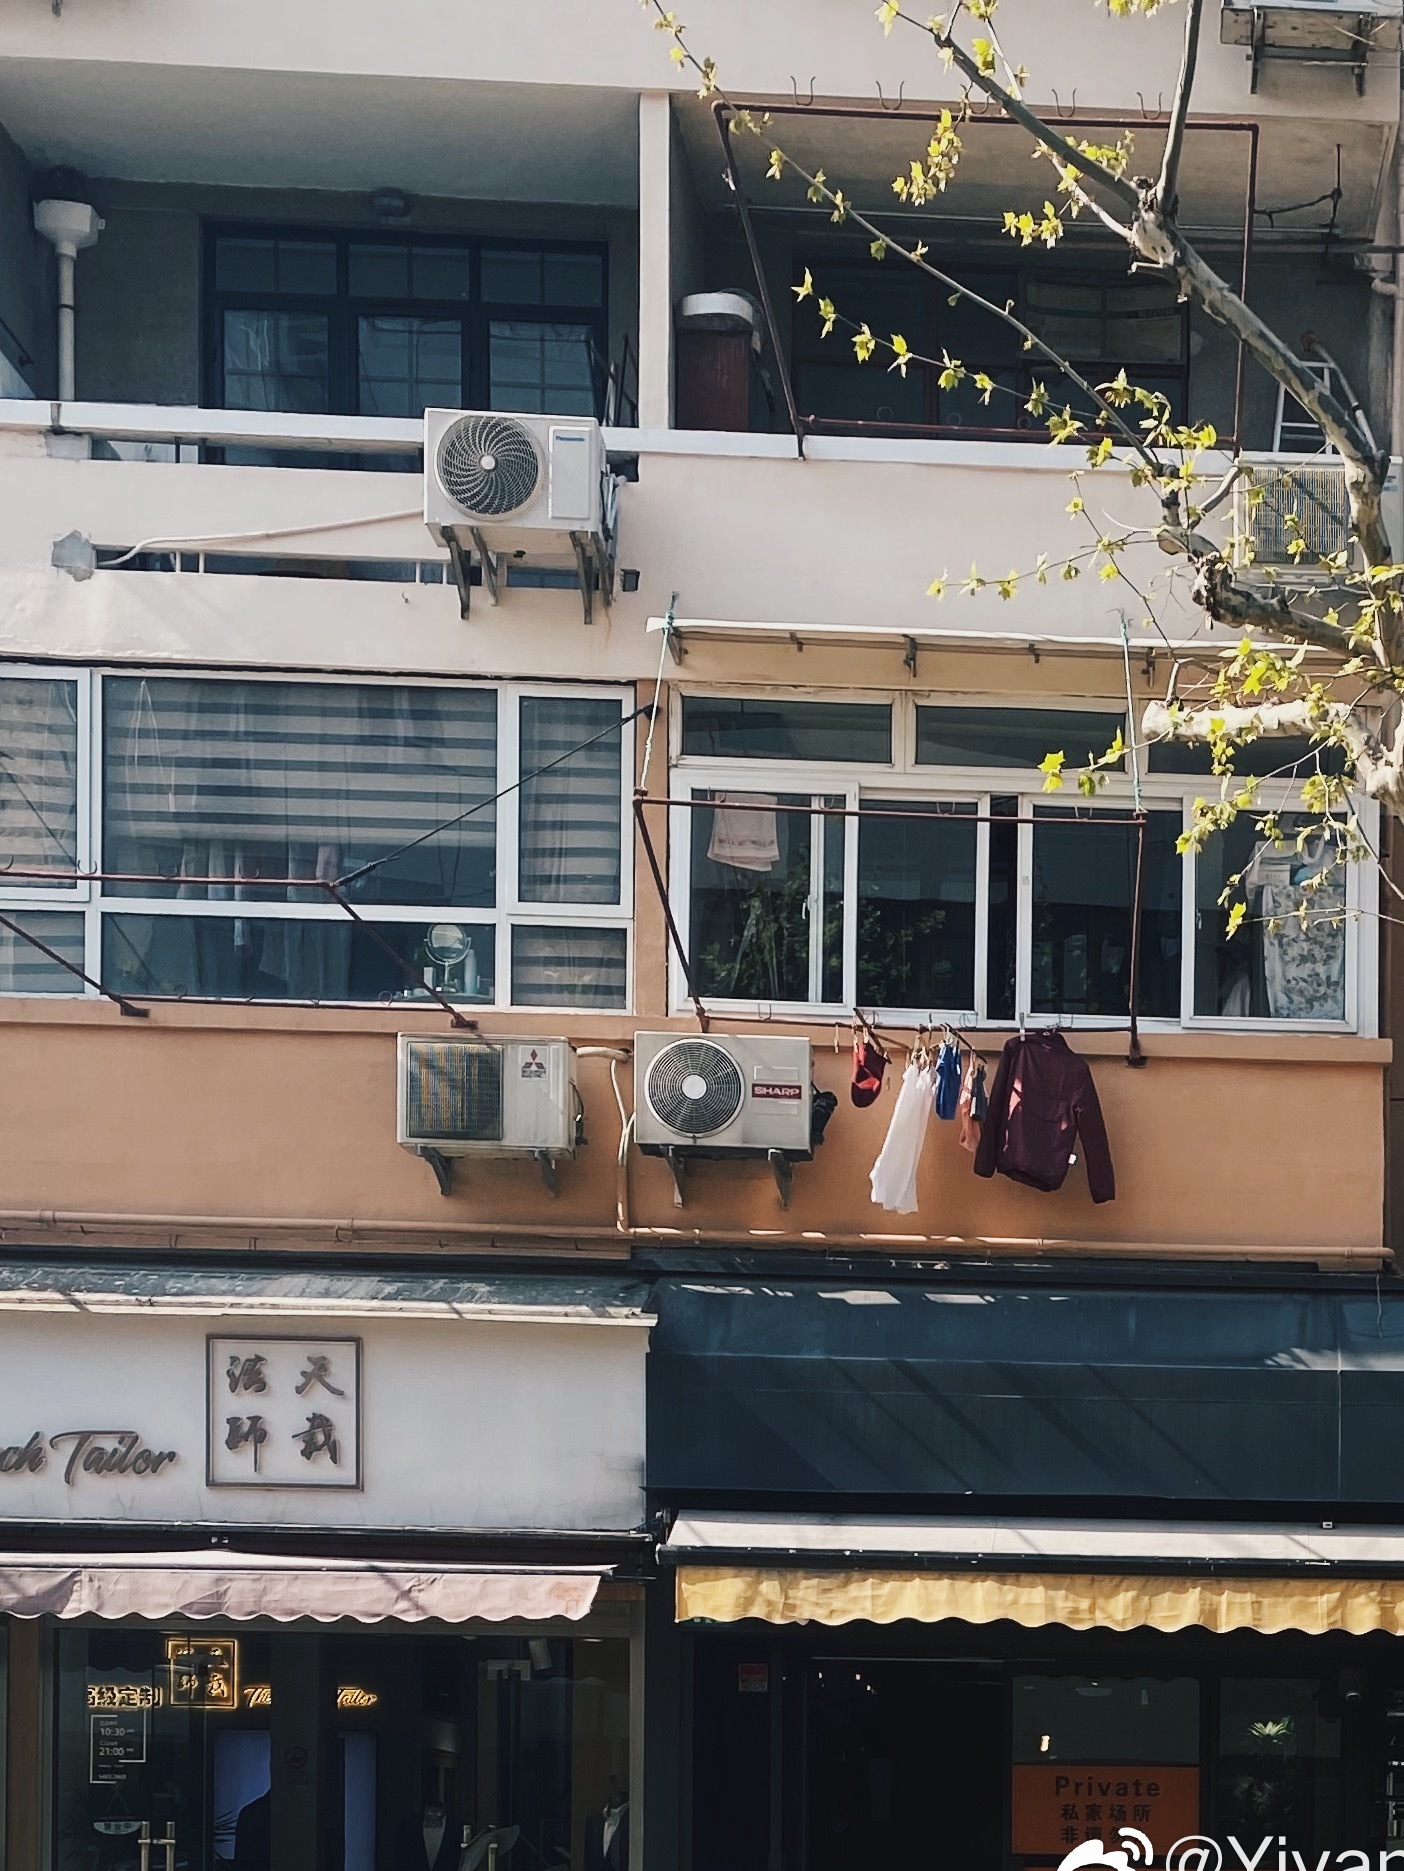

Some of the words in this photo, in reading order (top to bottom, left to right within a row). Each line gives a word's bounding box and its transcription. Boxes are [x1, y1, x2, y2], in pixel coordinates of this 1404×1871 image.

[754, 1086, 800, 1096] SHARP
[50, 1430, 177, 1485] Tailor
[100, 1727, 126, 1737] 10:30
[98, 1747, 125, 1756] 21:00
[1055, 1775, 1161, 1797] Private
[1060, 1803, 1152, 1823] 私家场所
